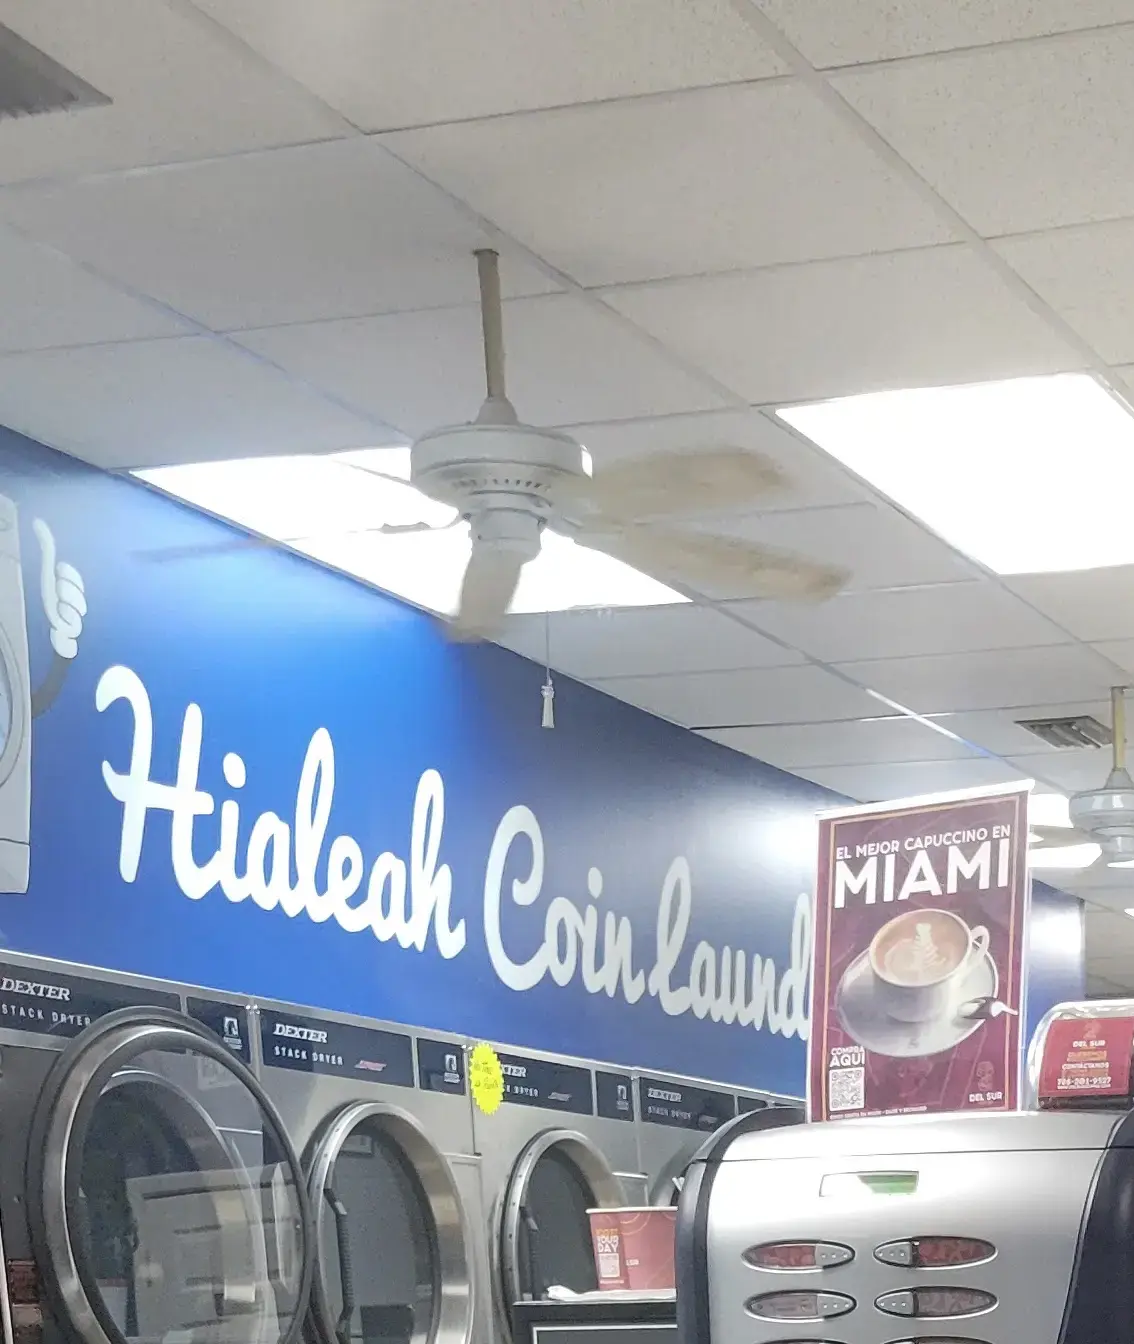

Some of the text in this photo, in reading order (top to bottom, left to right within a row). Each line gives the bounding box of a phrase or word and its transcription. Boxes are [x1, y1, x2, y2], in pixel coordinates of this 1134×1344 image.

[95, 665, 466, 959] Hialeah
[484, 805, 645, 1004] Coin
[836, 825, 1011, 860] EL MEJOR CAPUCCINO EN
[834, 839, 1010, 908] MIAMI
[1, 977, 71, 1001] DEXTER
[1, 1003, 45, 1020] STACK
[273, 1023, 328, 1044] DEXTER
[274, 1046, 343, 1066] STACK DRYER
[969, 1091, 1002, 1102] DEL SUR
[597, 1242, 619, 1253] DAY
